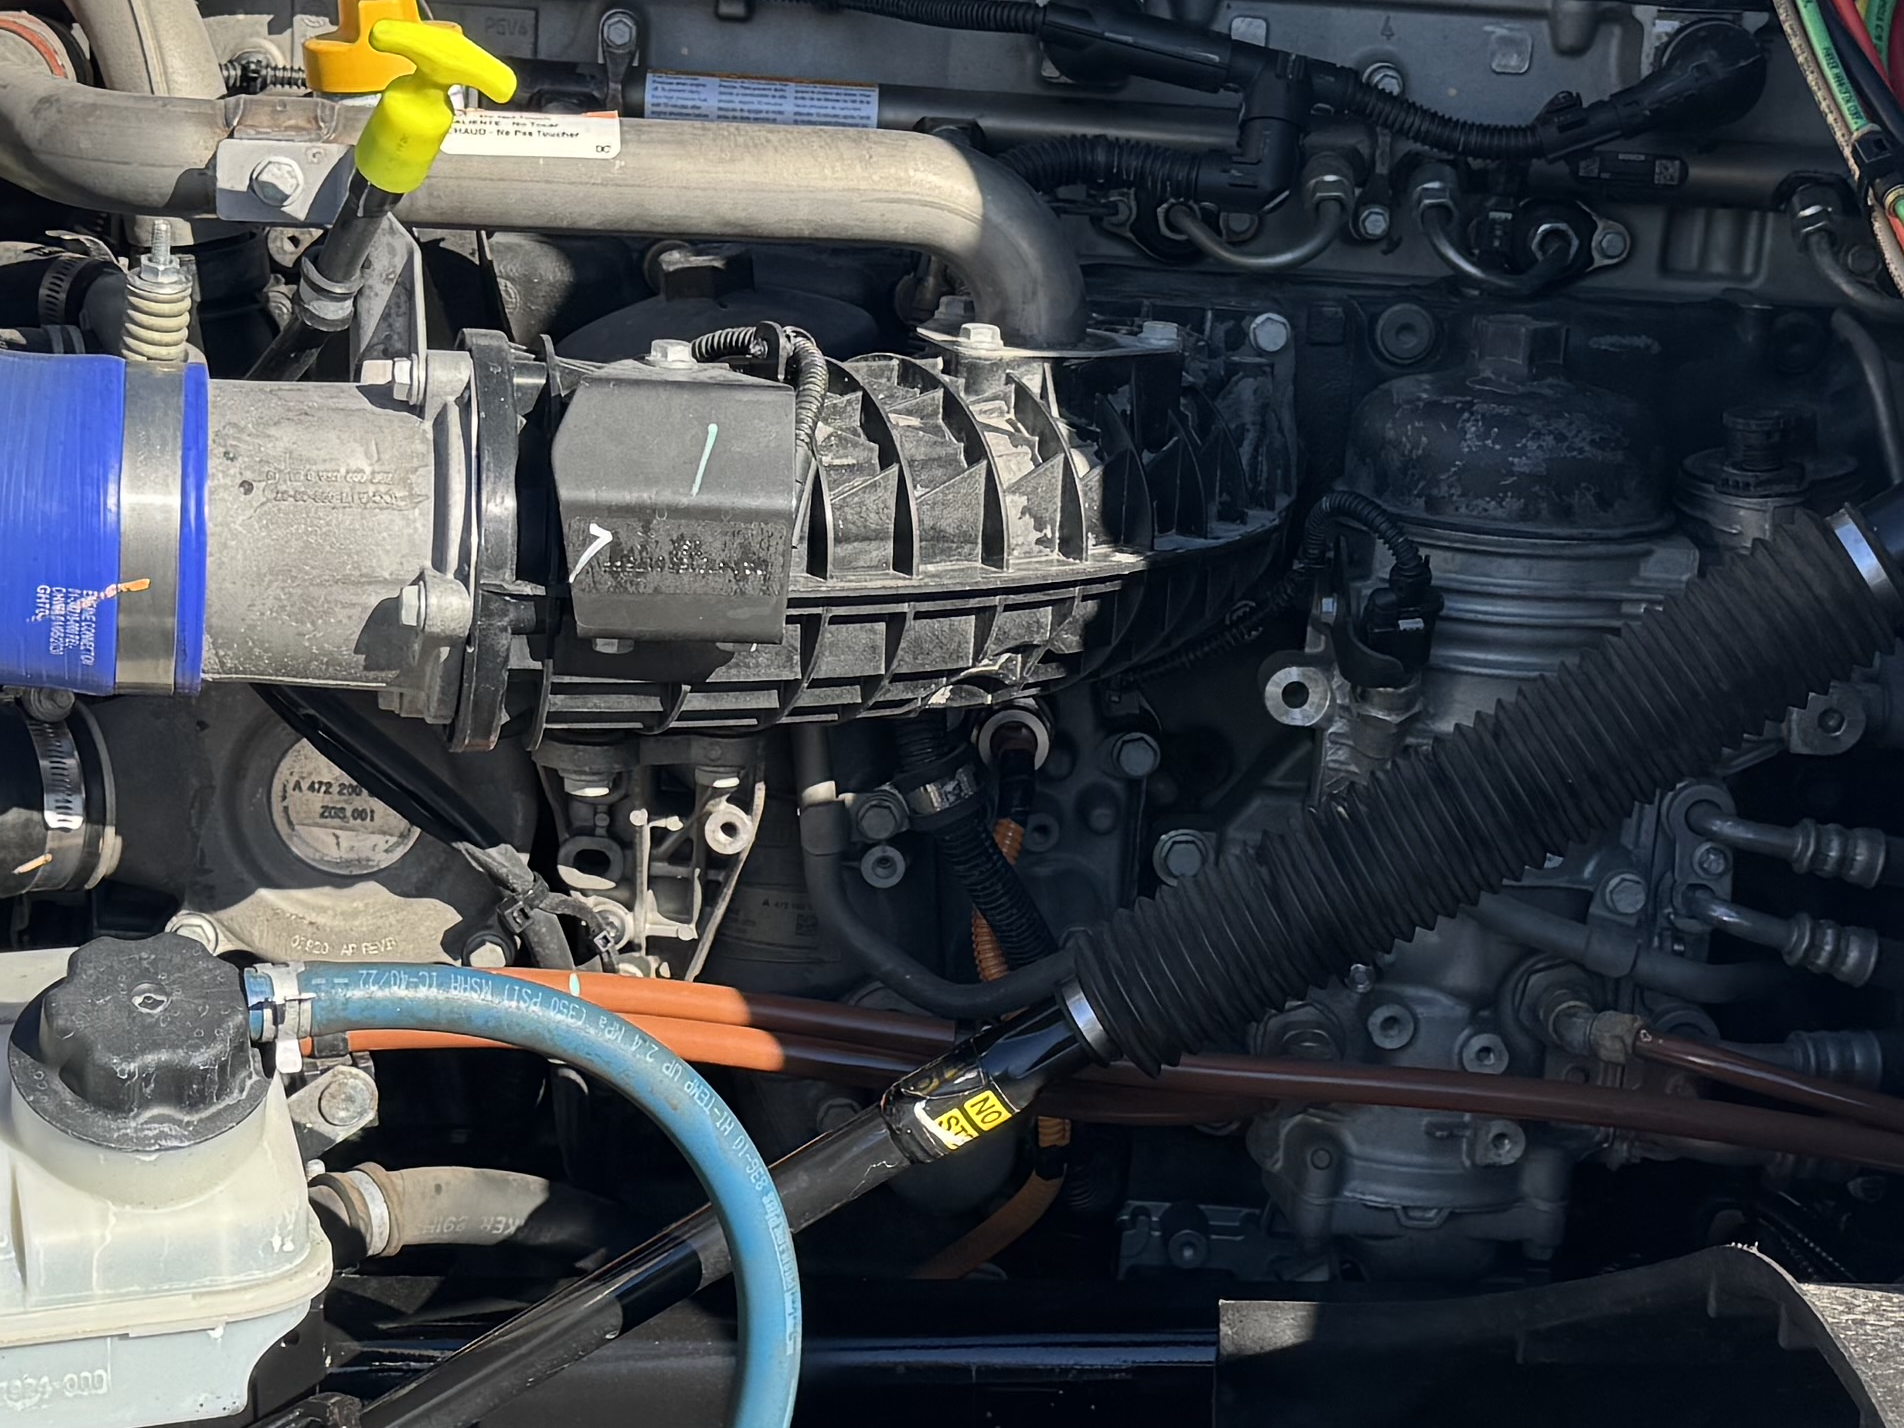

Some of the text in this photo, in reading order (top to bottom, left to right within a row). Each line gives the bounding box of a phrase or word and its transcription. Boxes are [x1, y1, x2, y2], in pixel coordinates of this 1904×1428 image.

[293, 780, 363, 796] A 472 200
[358, 969, 437, 990] IC-40/22
[450, 973, 492, 998] MSHA
[502, 982, 541, 1008] PSI)
[598, 1014, 623, 1040] MPa
[681, 1075, 736, 1135] HI-TEMP
[970, 1095, 1002, 1126] NO
[730, 1134, 772, 1190] 836-10
